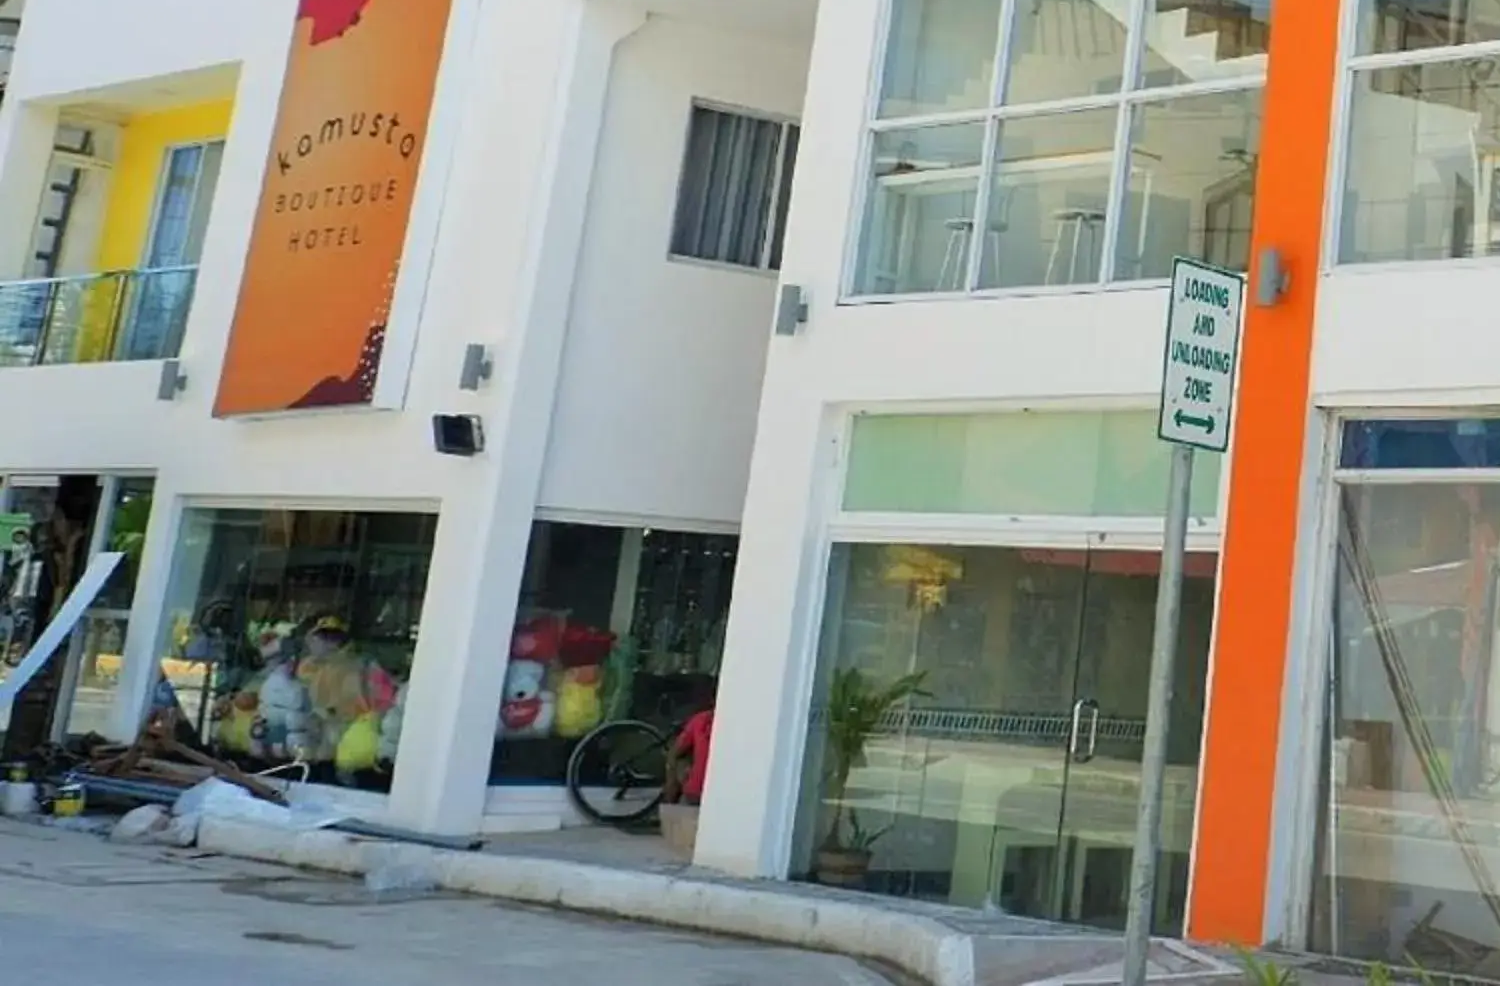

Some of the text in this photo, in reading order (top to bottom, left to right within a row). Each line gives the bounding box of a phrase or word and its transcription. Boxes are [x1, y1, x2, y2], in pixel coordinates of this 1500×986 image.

[274, 178, 397, 214] BOUTIQUE
[288, 224, 362, 253] HOTEL
[1185, 278, 1230, 309] LOADING
[1193, 312, 1215, 338] AND
[1171, 341, 1231, 375] UNLOADING
[1183, 377, 1213, 404] ZONE
